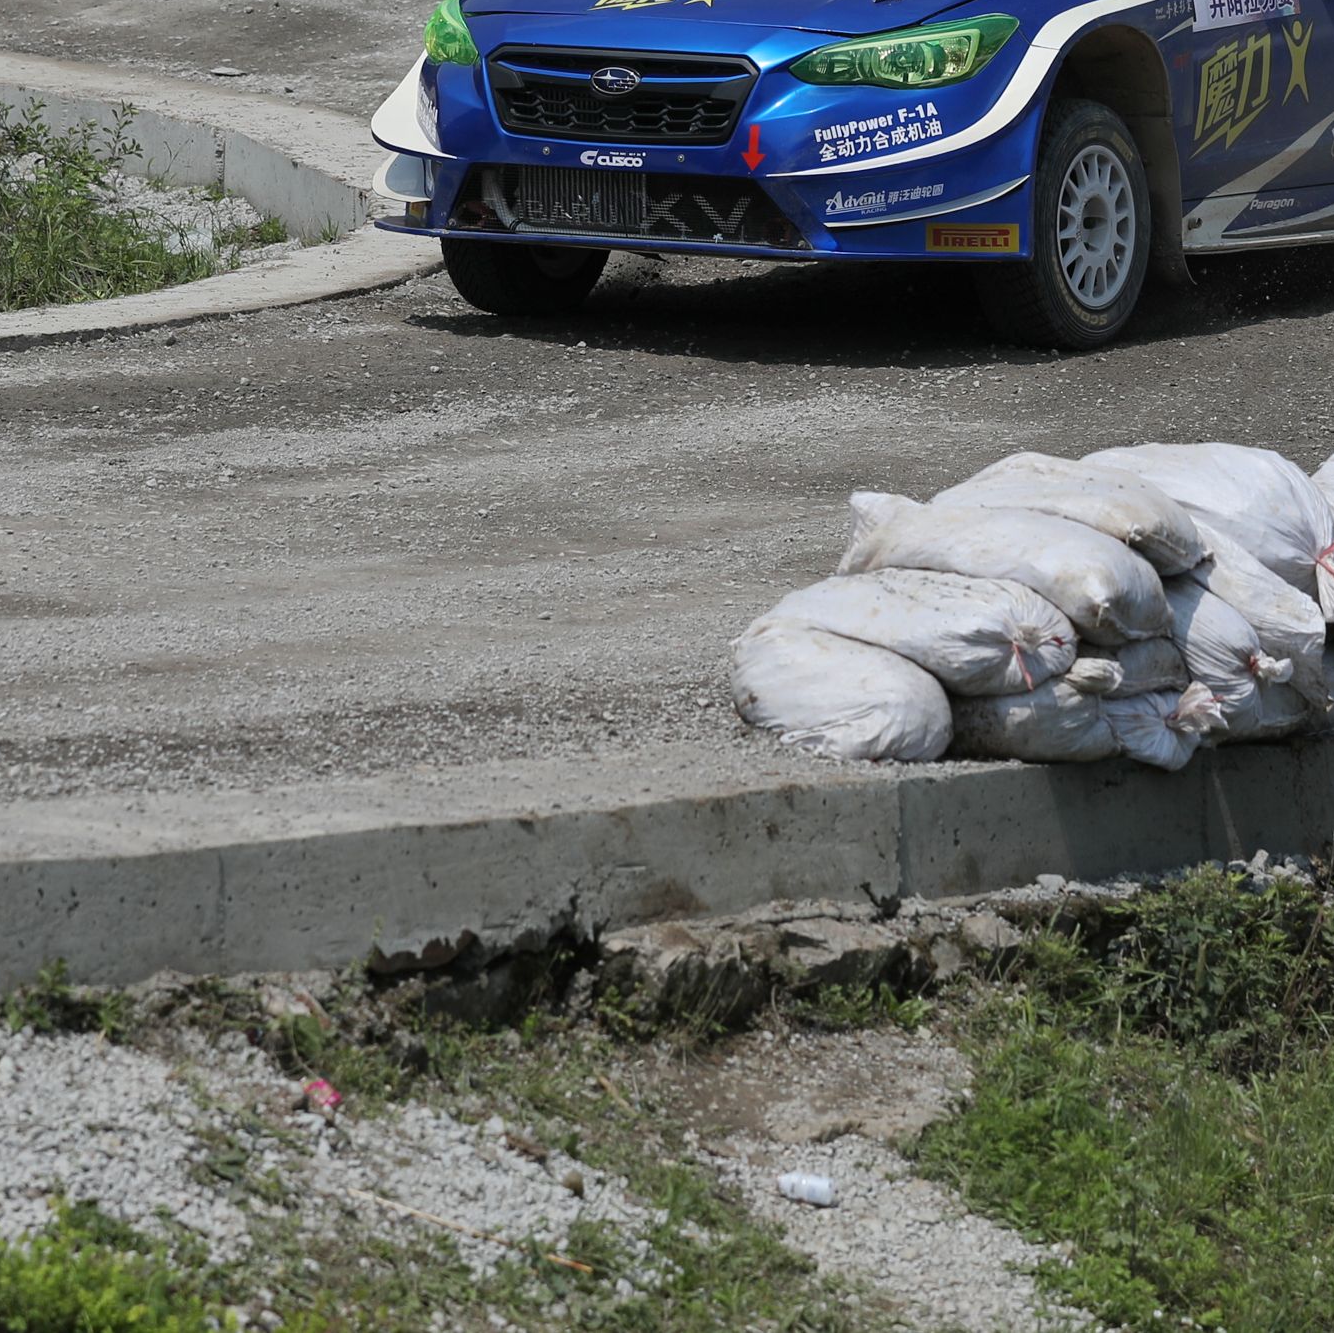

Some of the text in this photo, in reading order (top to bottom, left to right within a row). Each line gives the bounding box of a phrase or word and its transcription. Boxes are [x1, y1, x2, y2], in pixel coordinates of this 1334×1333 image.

[1193, 32, 1272, 142] 魔力
[814, 102, 938, 143] FullyPower F-1A
[818, 118, 943, 163] 全动力合成机油
[825, 190, 886, 212] Advanti
[1250, 197, 1294, 210] Paragon
[932, 228, 1010, 248] PIRELLI
